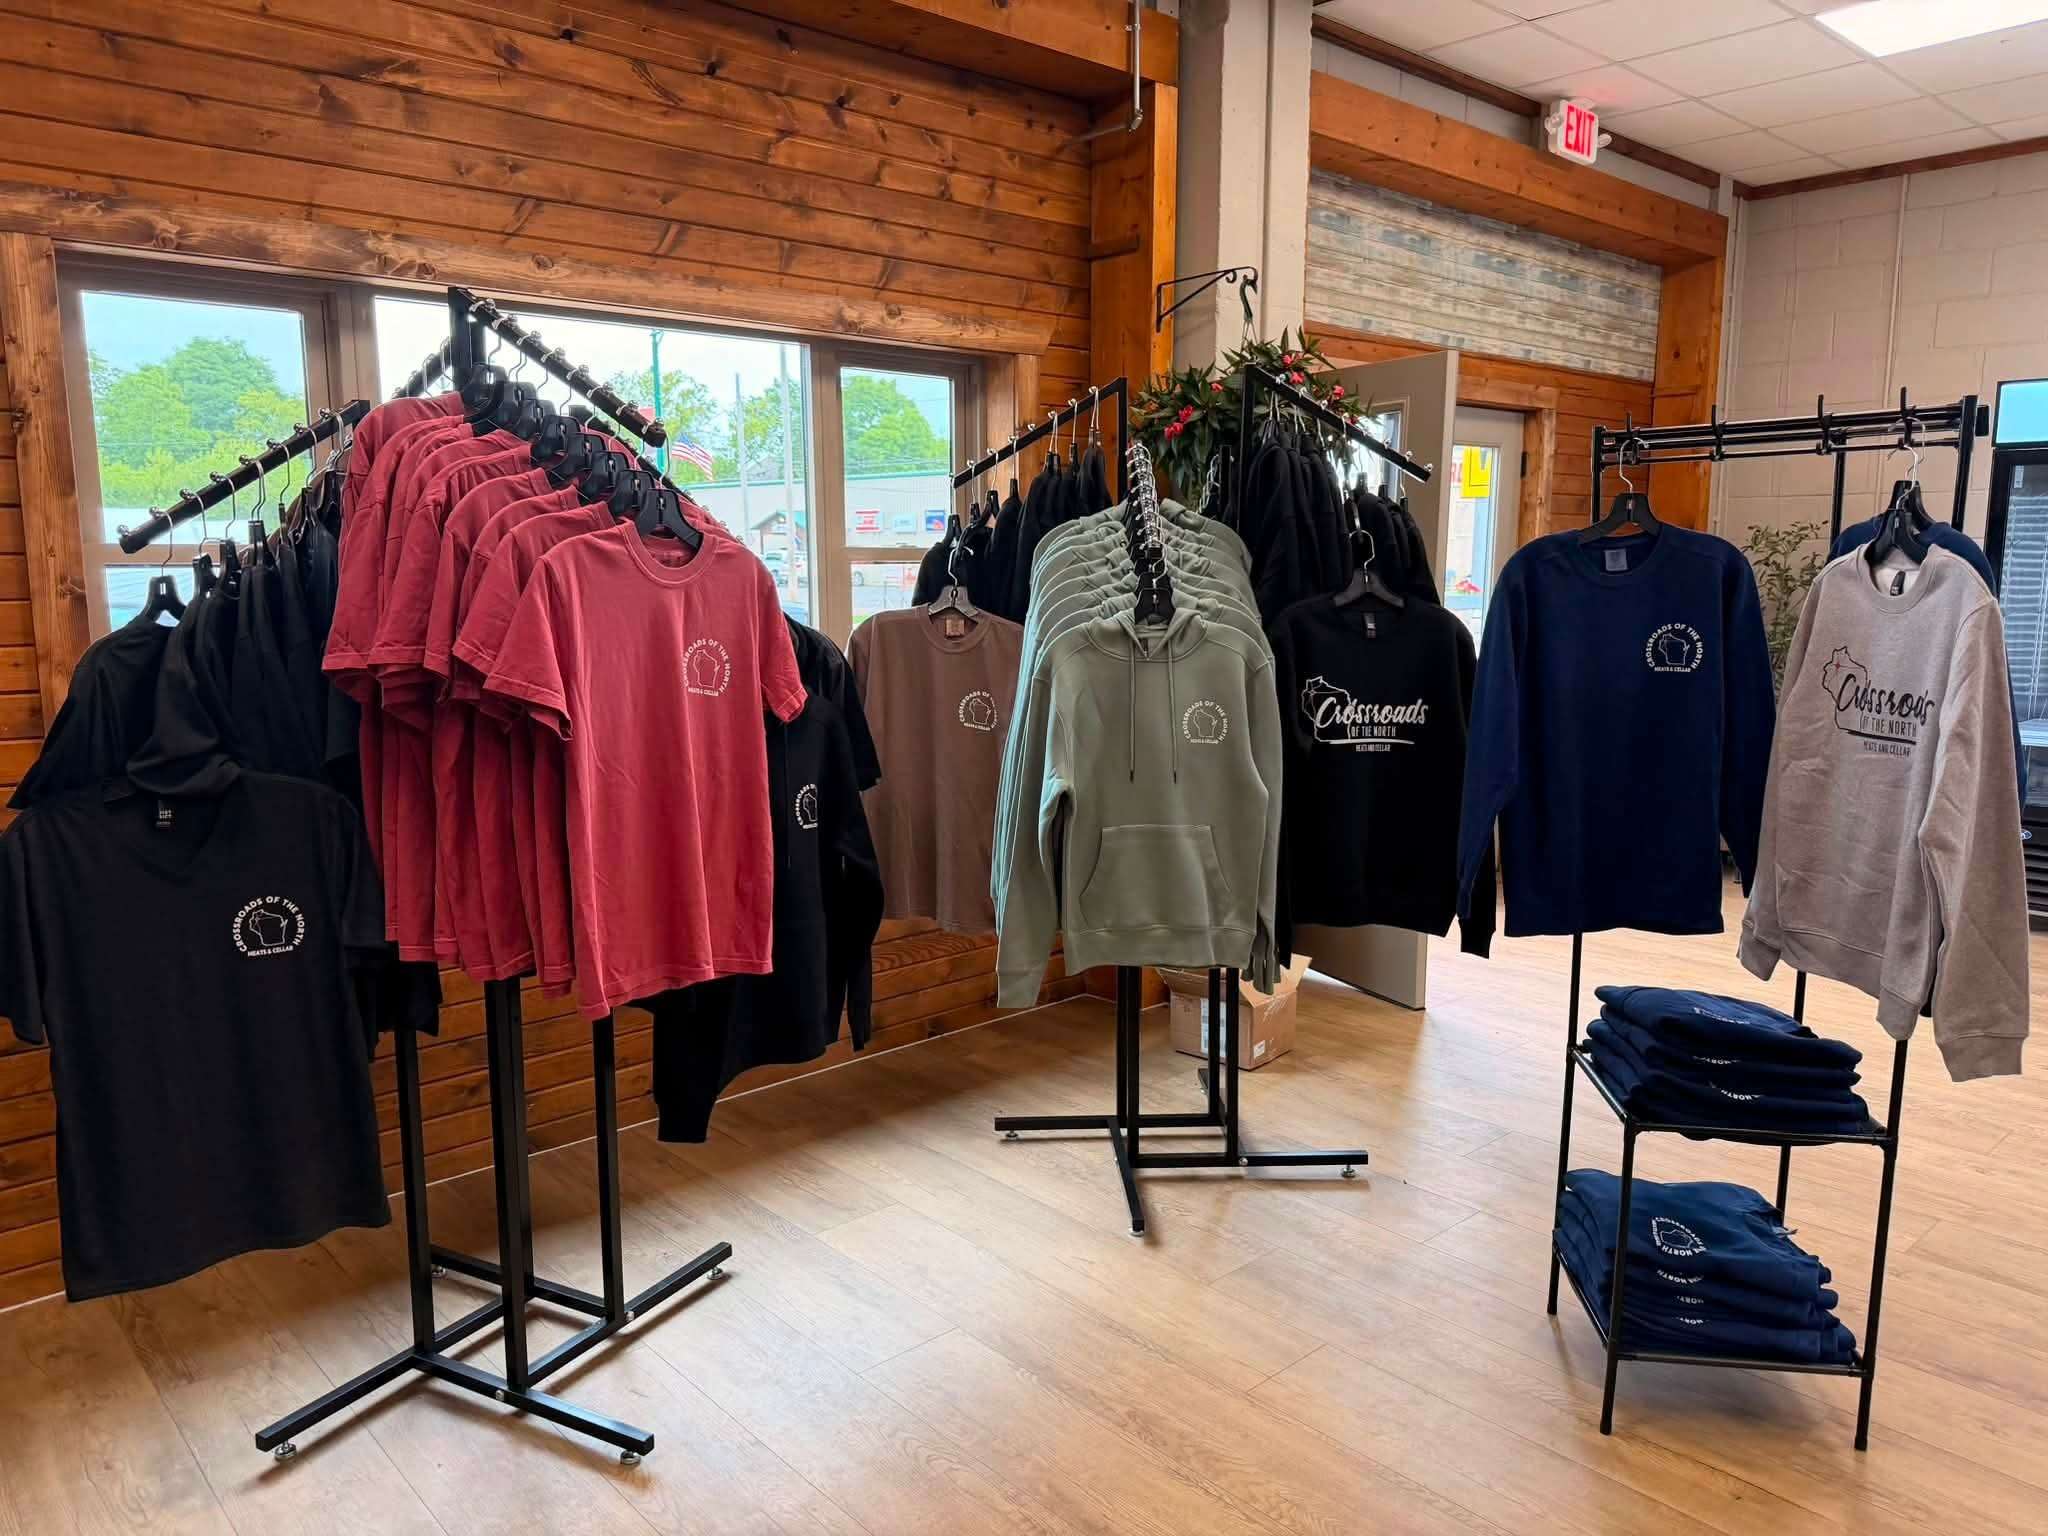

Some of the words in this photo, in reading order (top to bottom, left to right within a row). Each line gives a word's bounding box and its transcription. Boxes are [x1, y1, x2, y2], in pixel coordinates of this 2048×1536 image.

[1565, 103, 1595, 158] EXIT
[1674, 622, 1687, 631] OF
[1686, 626, 1701, 641] THE
[707, 638, 719, 648] OF
[1645, 623, 1673, 668] CROSSROADS
[718, 644, 730, 662] THE
[1690, 641, 1704, 670] NORTH
[718, 663, 731, 693] NORTH
[1204, 700, 1215, 708] OF
[1215, 704, 1226, 717] THE
[1316, 696, 1429, 728] Crossroads
[1217, 718, 1228, 742] NORTH
[1350, 725, 1360, 737] OF
[1361, 725, 1372, 737] THE
[1373, 725, 1397, 737] NORTH
[1871, 716, 1885, 734] THE
[1888, 719, 1917, 738] NORTH
[1878, 742, 1889, 754] AND
[232, 897, 264, 953] CROSSROADS
[265, 895, 281, 904] OF
[281, 898, 300, 914] THE
[292, 913, 305, 947] NORTH
[272, 945, 294, 954] CELLAR
[1661, 1245, 1694, 1257] NORTH
